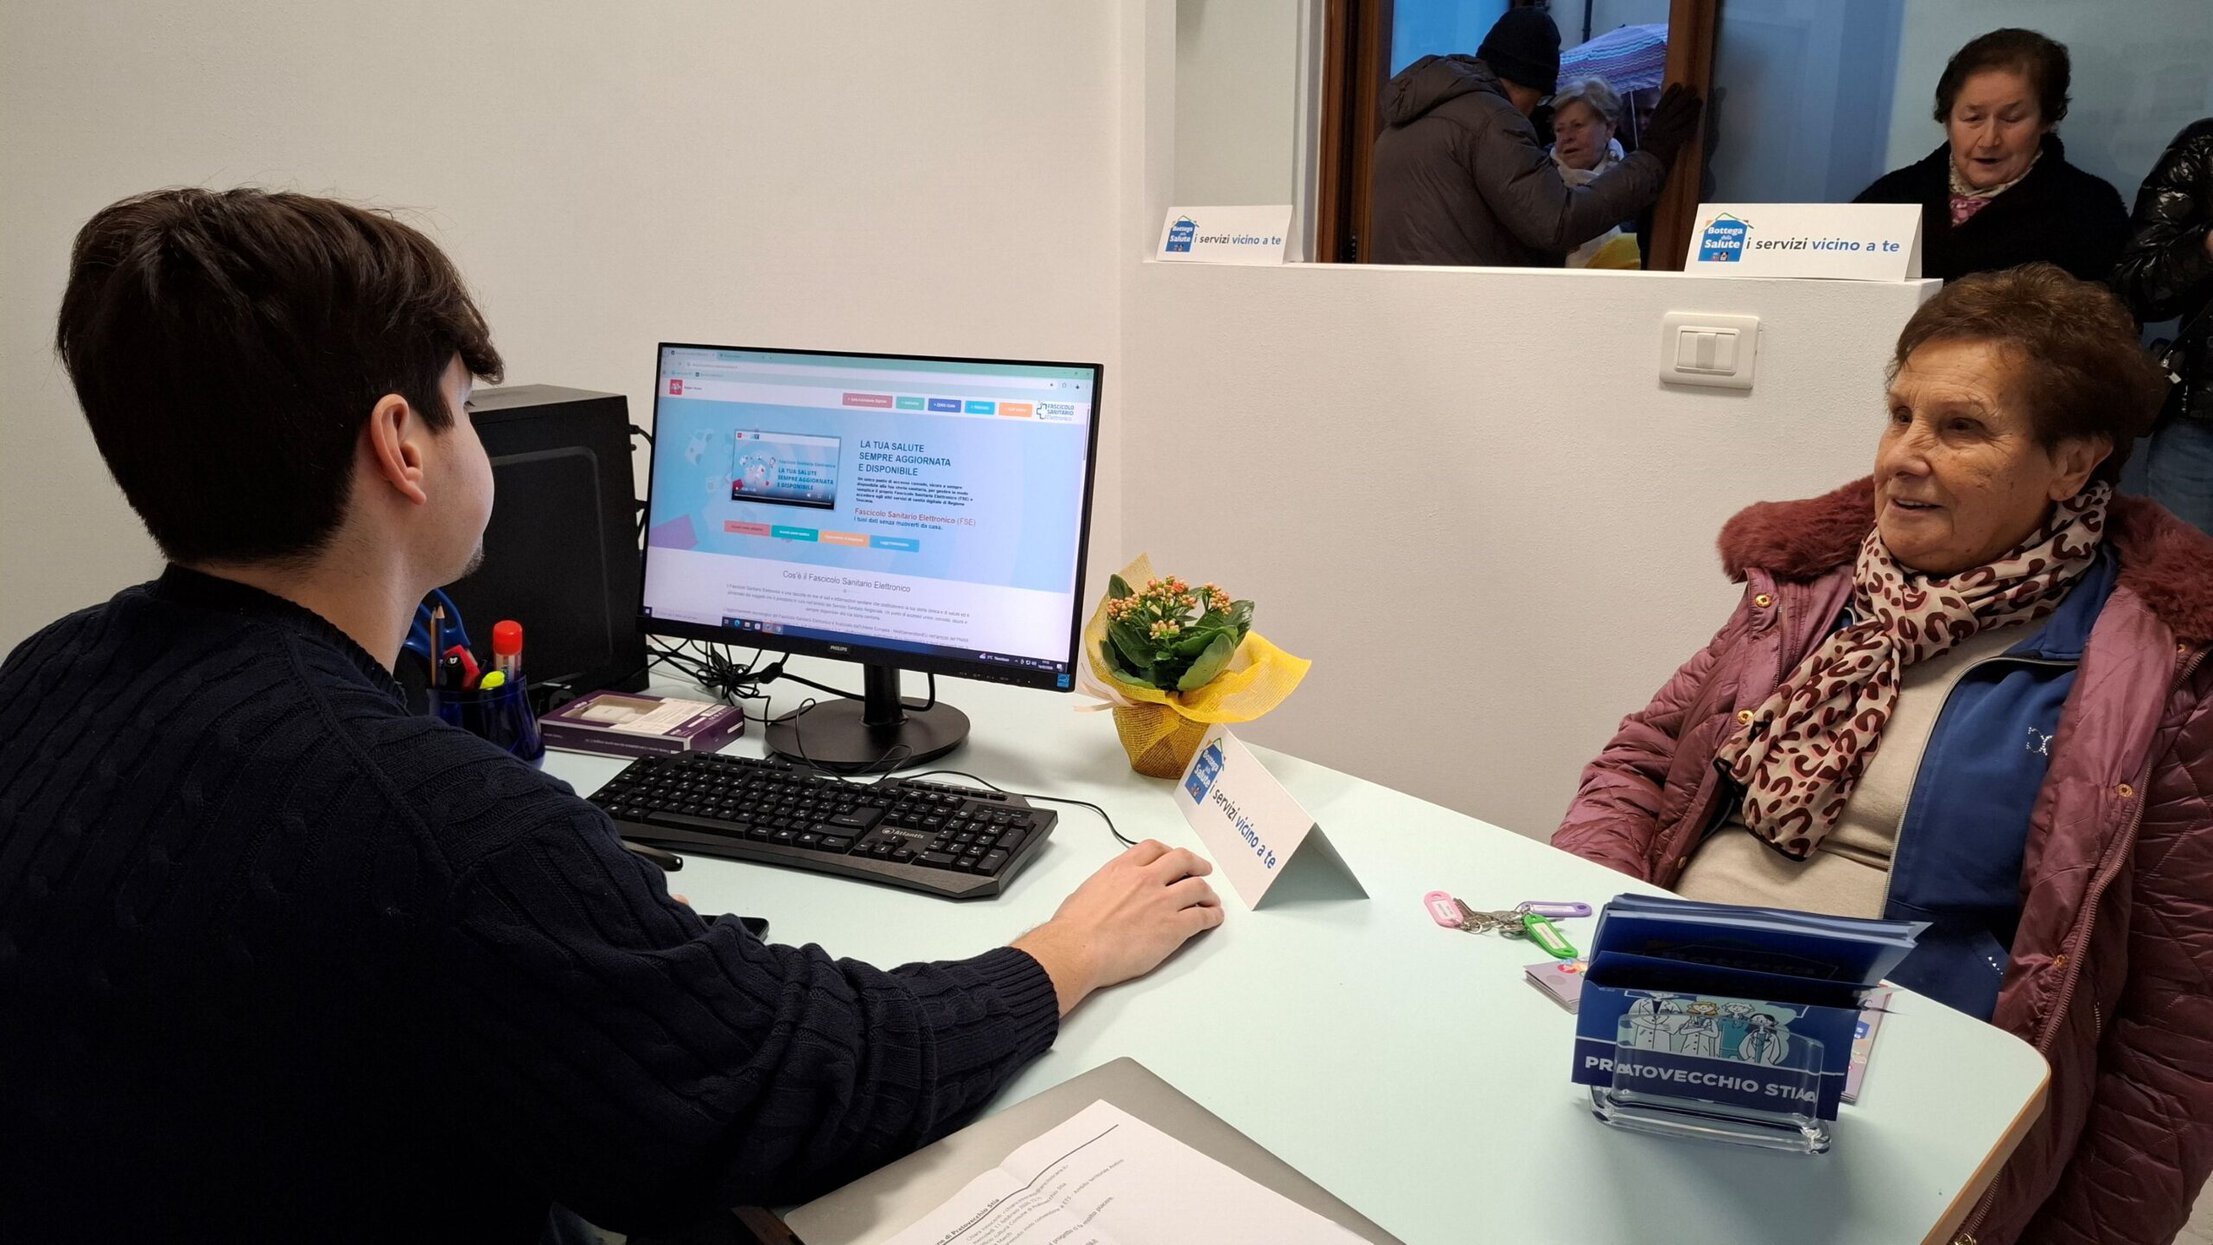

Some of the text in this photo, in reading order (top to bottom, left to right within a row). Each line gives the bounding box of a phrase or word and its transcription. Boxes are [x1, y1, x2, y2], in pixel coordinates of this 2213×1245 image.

[1170, 234, 1191, 242] Salute
[1708, 227, 1743, 236] Bottega
[1194, 234, 1198, 243] i
[1200, 234, 1230, 244] servizi
[1232, 235, 1260, 245] vicino
[1263, 237, 1268, 245] a
[1272, 236, 1281, 245] te
[1704, 239, 1741, 248] Salute
[1746, 237, 1900, 252] i servizi vicino a te
[860, 440, 925, 452] LA TUA SALUTE
[859, 452, 951, 467] SEMPRE AGGIORNATA
[866, 464, 918, 476] DISPONIBILE
[854, 508, 976, 527] Fascicolo Sanitario Elettronico (FSE)
[808, 574, 841, 585] Fascicolo
[842, 578, 872, 588] Sanitario
[874, 582, 911, 593] Elettronico
[1194, 764, 1211, 788] Salute
[1209, 780, 1276, 869] i servizi vicino a te
